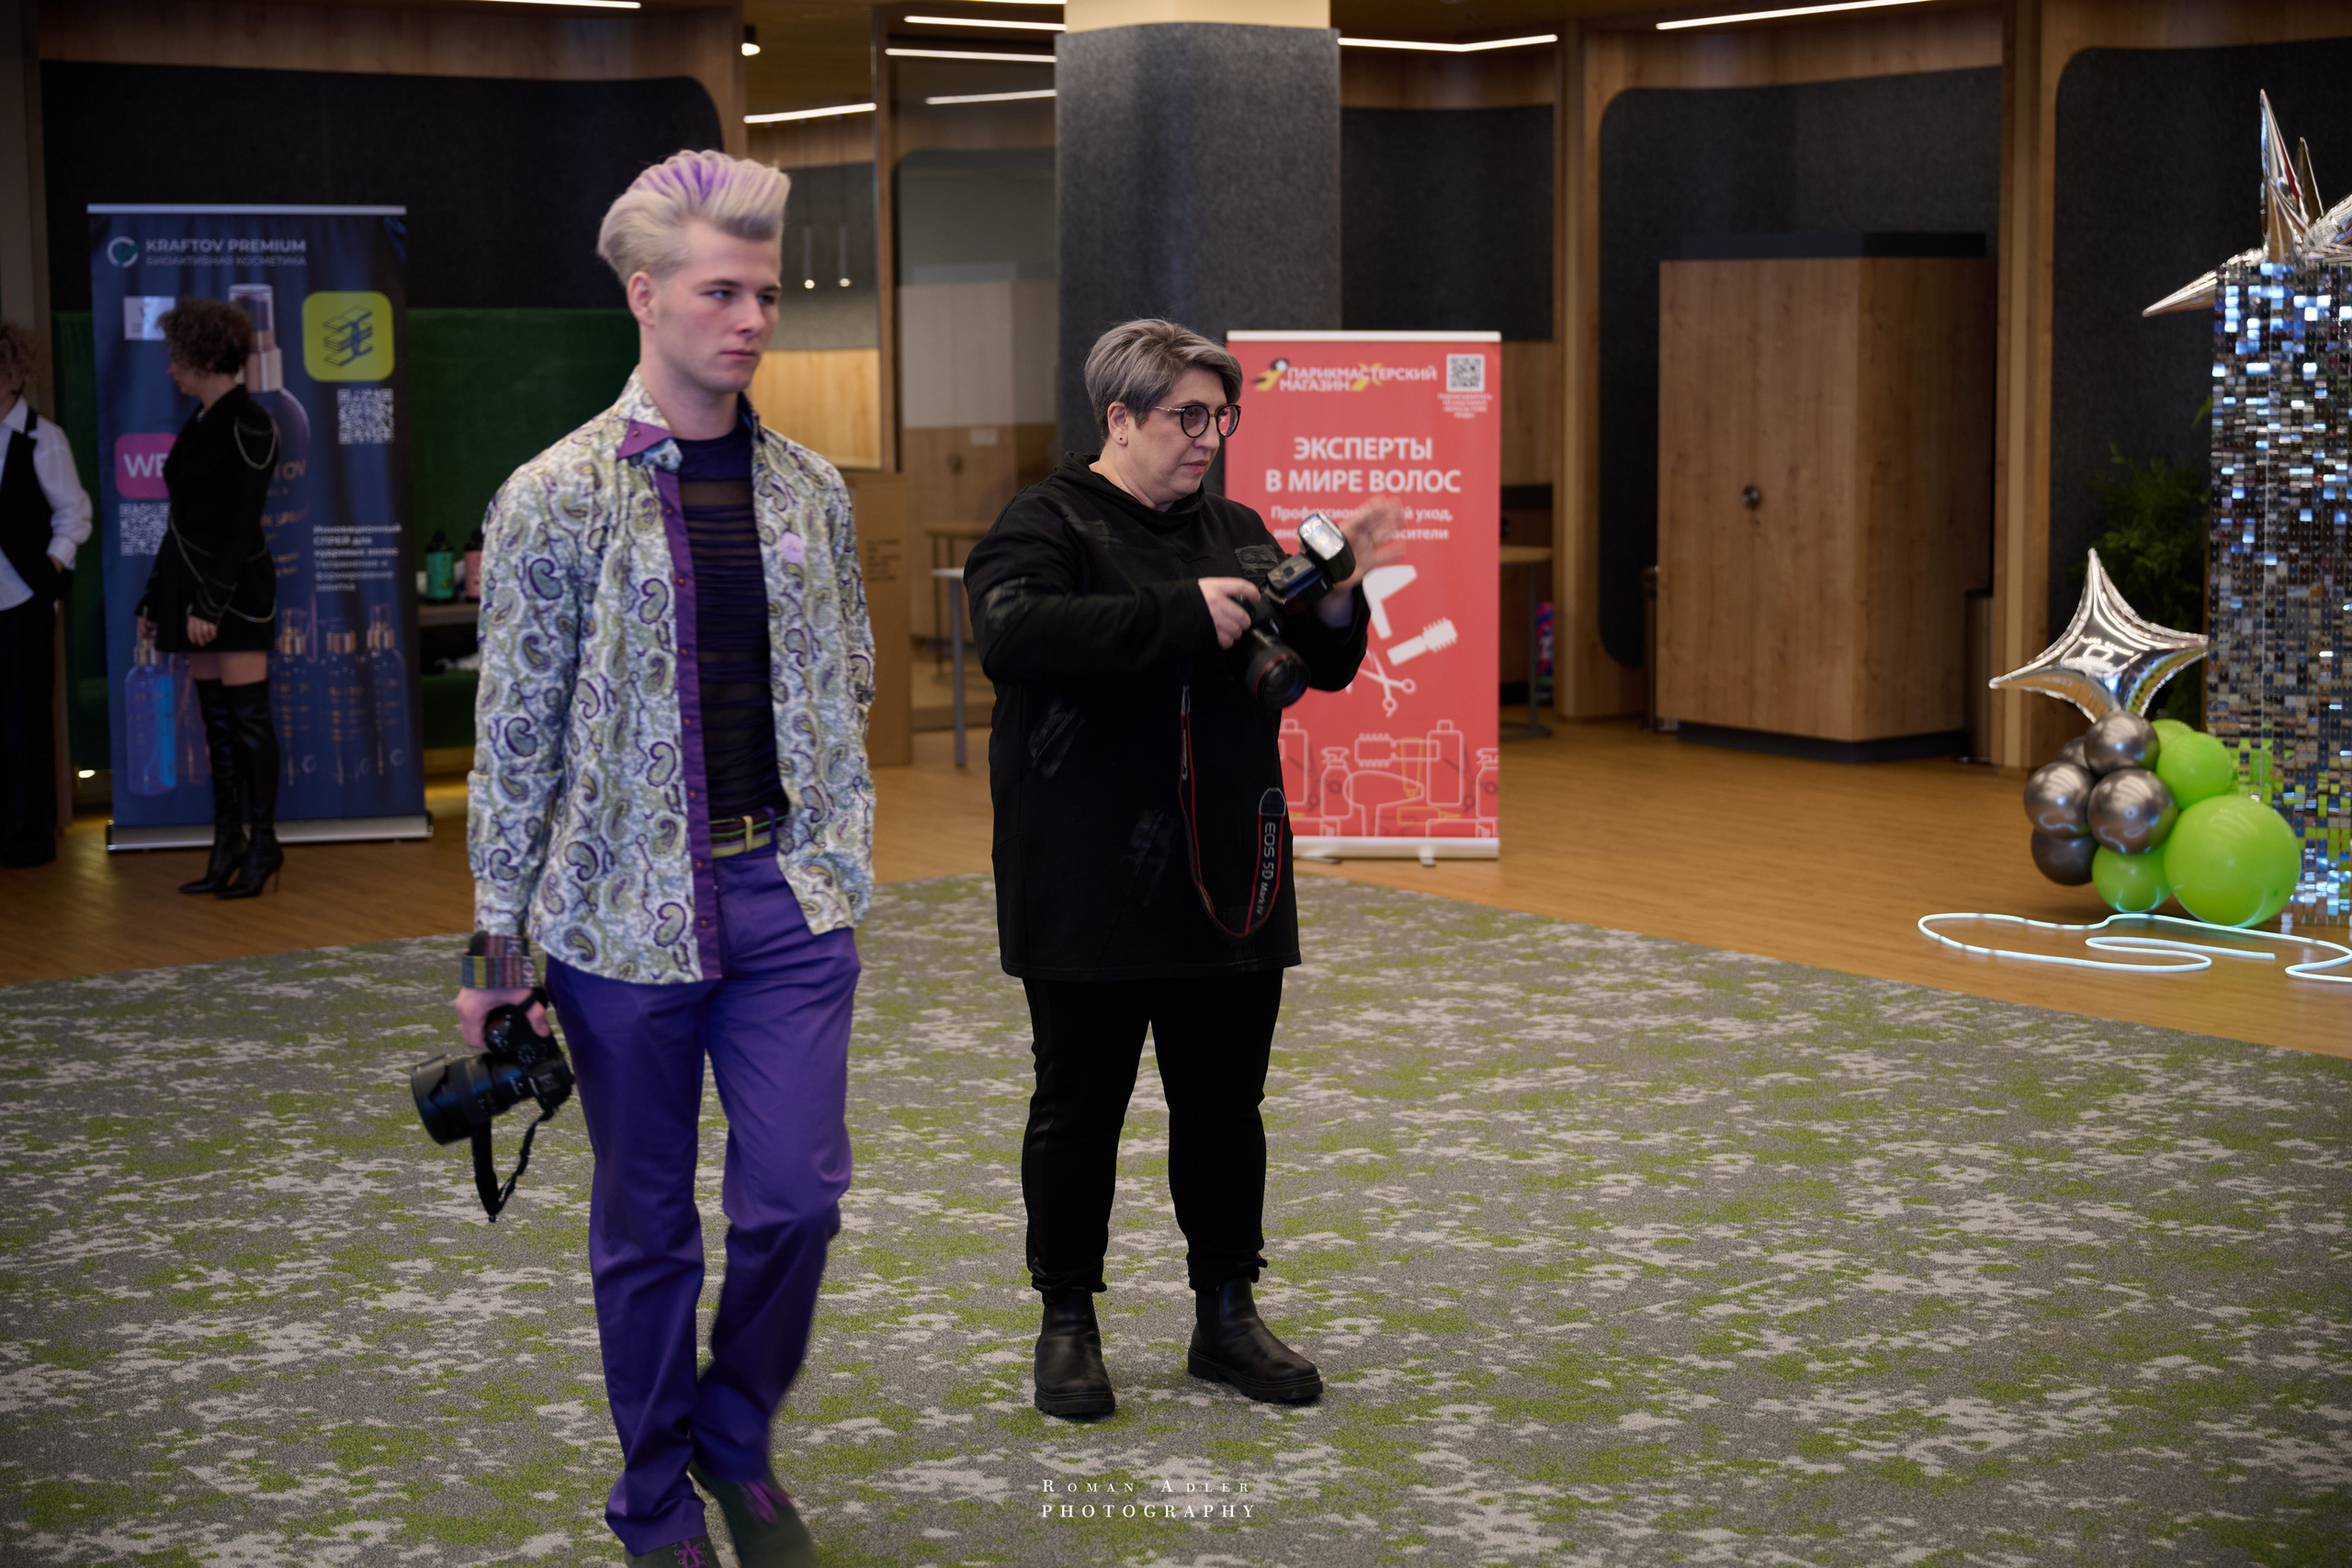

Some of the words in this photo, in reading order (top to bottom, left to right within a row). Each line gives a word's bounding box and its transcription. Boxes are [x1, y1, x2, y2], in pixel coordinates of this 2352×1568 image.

[146, 239, 224, 253] KRAFTOV
[228, 239, 307, 253] PREMIUM
[1288, 365, 1437, 381] ПАРИКМАСТЕРСКИЙ
[1280, 379, 1351, 392] МАГАЗИН
[1294, 437, 1432, 460] ЭКСПЕРТЫ
[1266, 470, 1283, 492] В
[1288, 470, 1363, 492] МИРЕ
[1369, 469, 1462, 493] ВОЛОС
[1415, 508, 1454, 523] уход,
[1263, 821, 1276, 858] EOS
[1261, 861, 1274, 880] 5D
[1258, 882, 1269, 905] Mark
